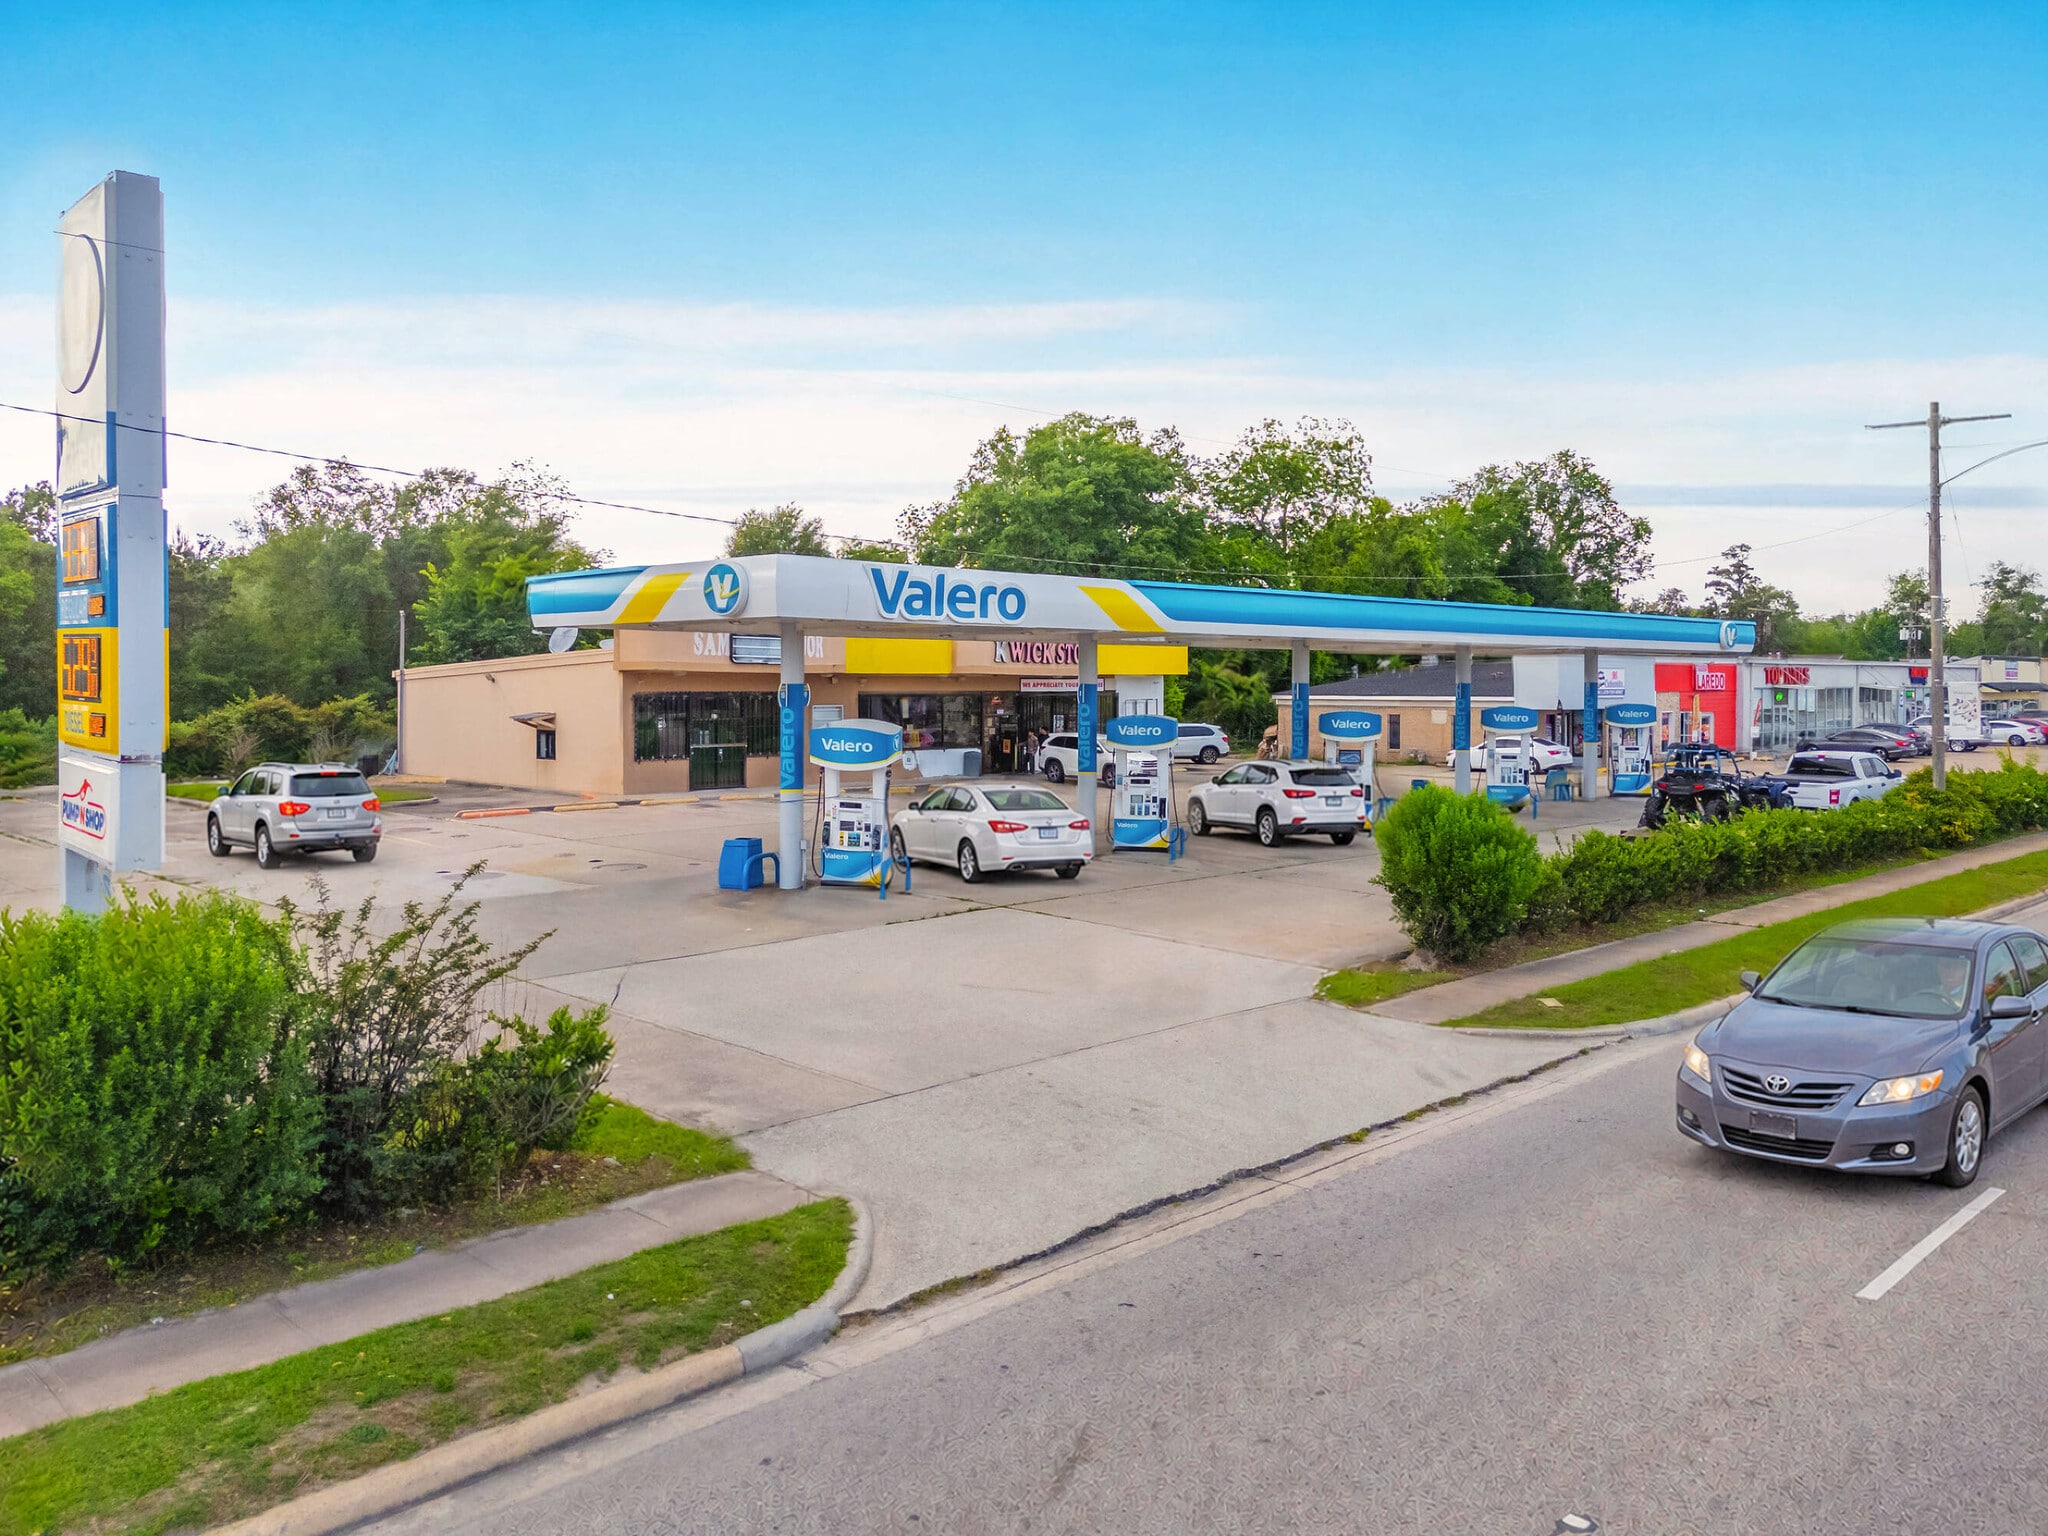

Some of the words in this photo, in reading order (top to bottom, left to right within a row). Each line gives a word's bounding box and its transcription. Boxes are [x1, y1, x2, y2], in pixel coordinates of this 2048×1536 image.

[870, 567, 1027, 621] Valero
[1697, 674, 1725, 689] LAREDO
[1493, 713, 1529, 723] Valero
[1617, 710, 1650, 718] Valero
[1118, 725, 1162, 736] Valero
[1331, 719, 1371, 729] Valero
[821, 737, 873, 753] Valero
[1078, 703, 1091, 772] Valero
[780, 707, 795, 788] Valero
[63, 799, 80, 823] PUMP
[85, 807, 104, 832] SHOP
[824, 852, 849, 860] Valero
